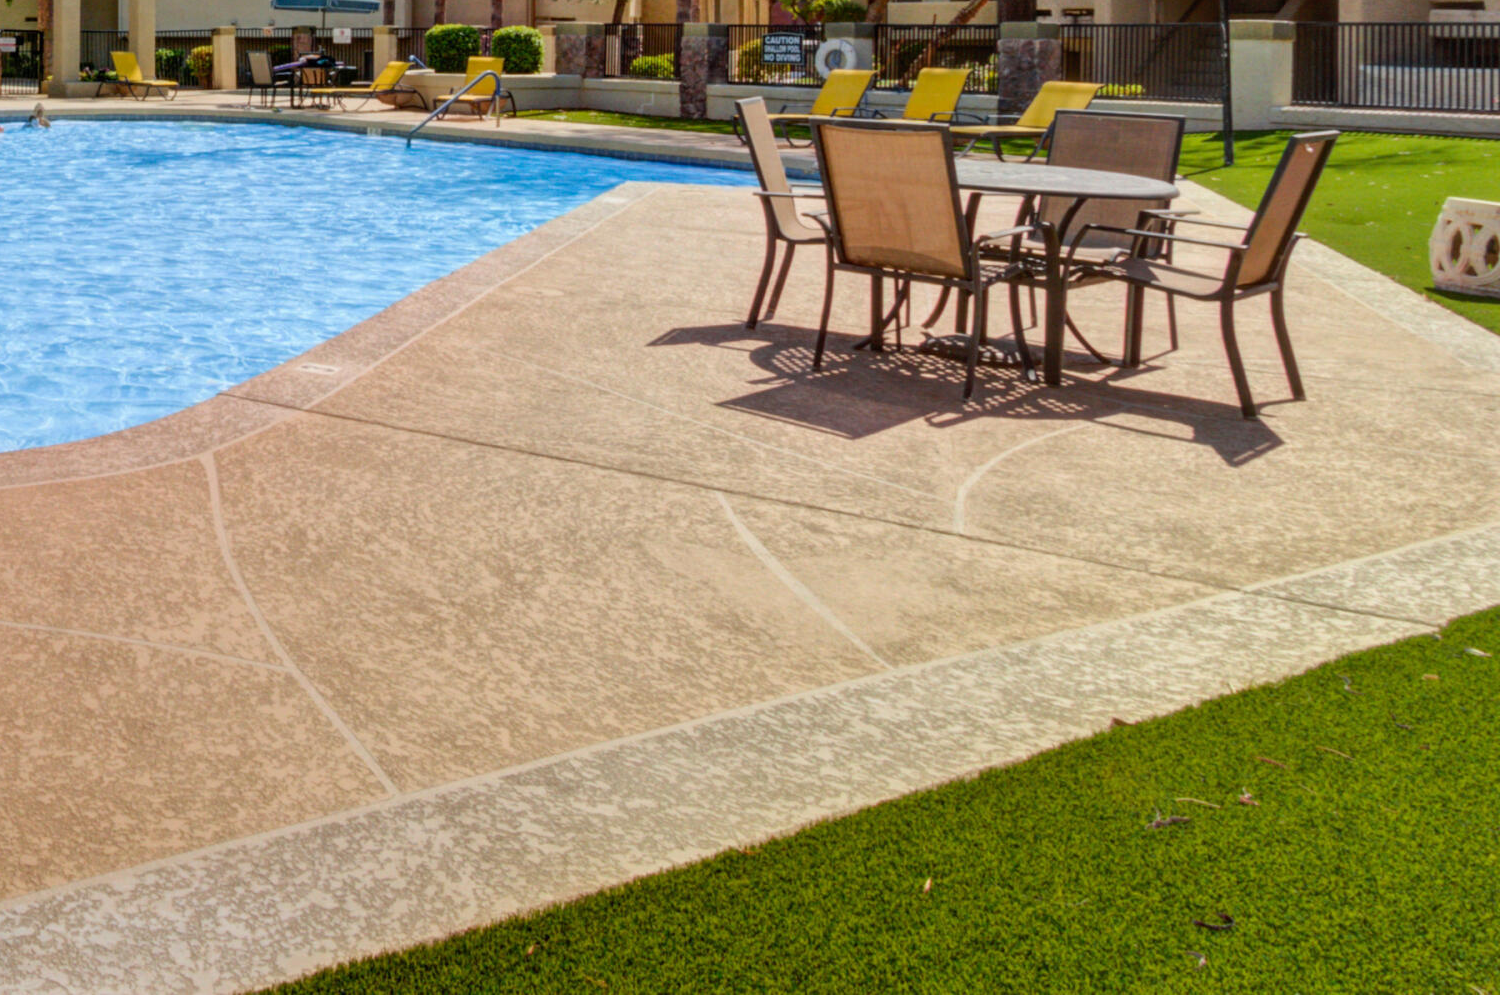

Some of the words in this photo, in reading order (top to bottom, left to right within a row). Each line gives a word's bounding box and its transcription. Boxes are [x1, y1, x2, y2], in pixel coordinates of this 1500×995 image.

[765, 36, 800, 45] CAUTION
[787, 45, 801, 53] POOL
[764, 54, 775, 62] NO
[776, 54, 801, 62] DIVING
